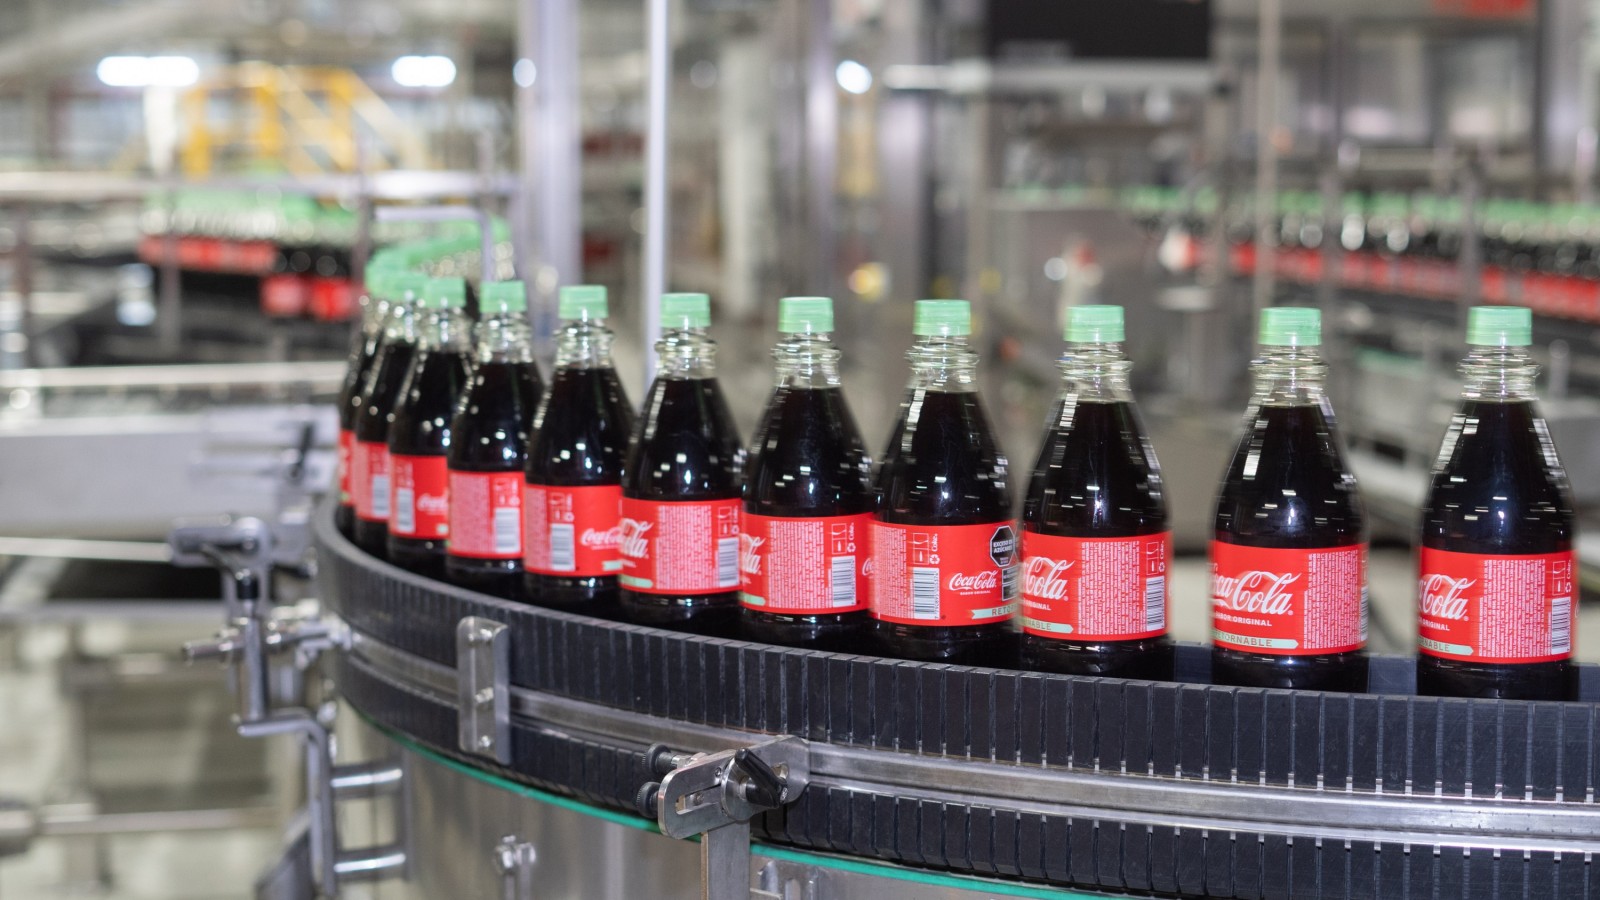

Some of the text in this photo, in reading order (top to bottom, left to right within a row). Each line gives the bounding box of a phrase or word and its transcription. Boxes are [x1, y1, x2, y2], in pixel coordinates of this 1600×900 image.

[949, 570, 999, 591] Coca-Cola
[1232, 616, 1272, 627] ORIGINAL
[1422, 618, 1450, 631] ORIGINAL
